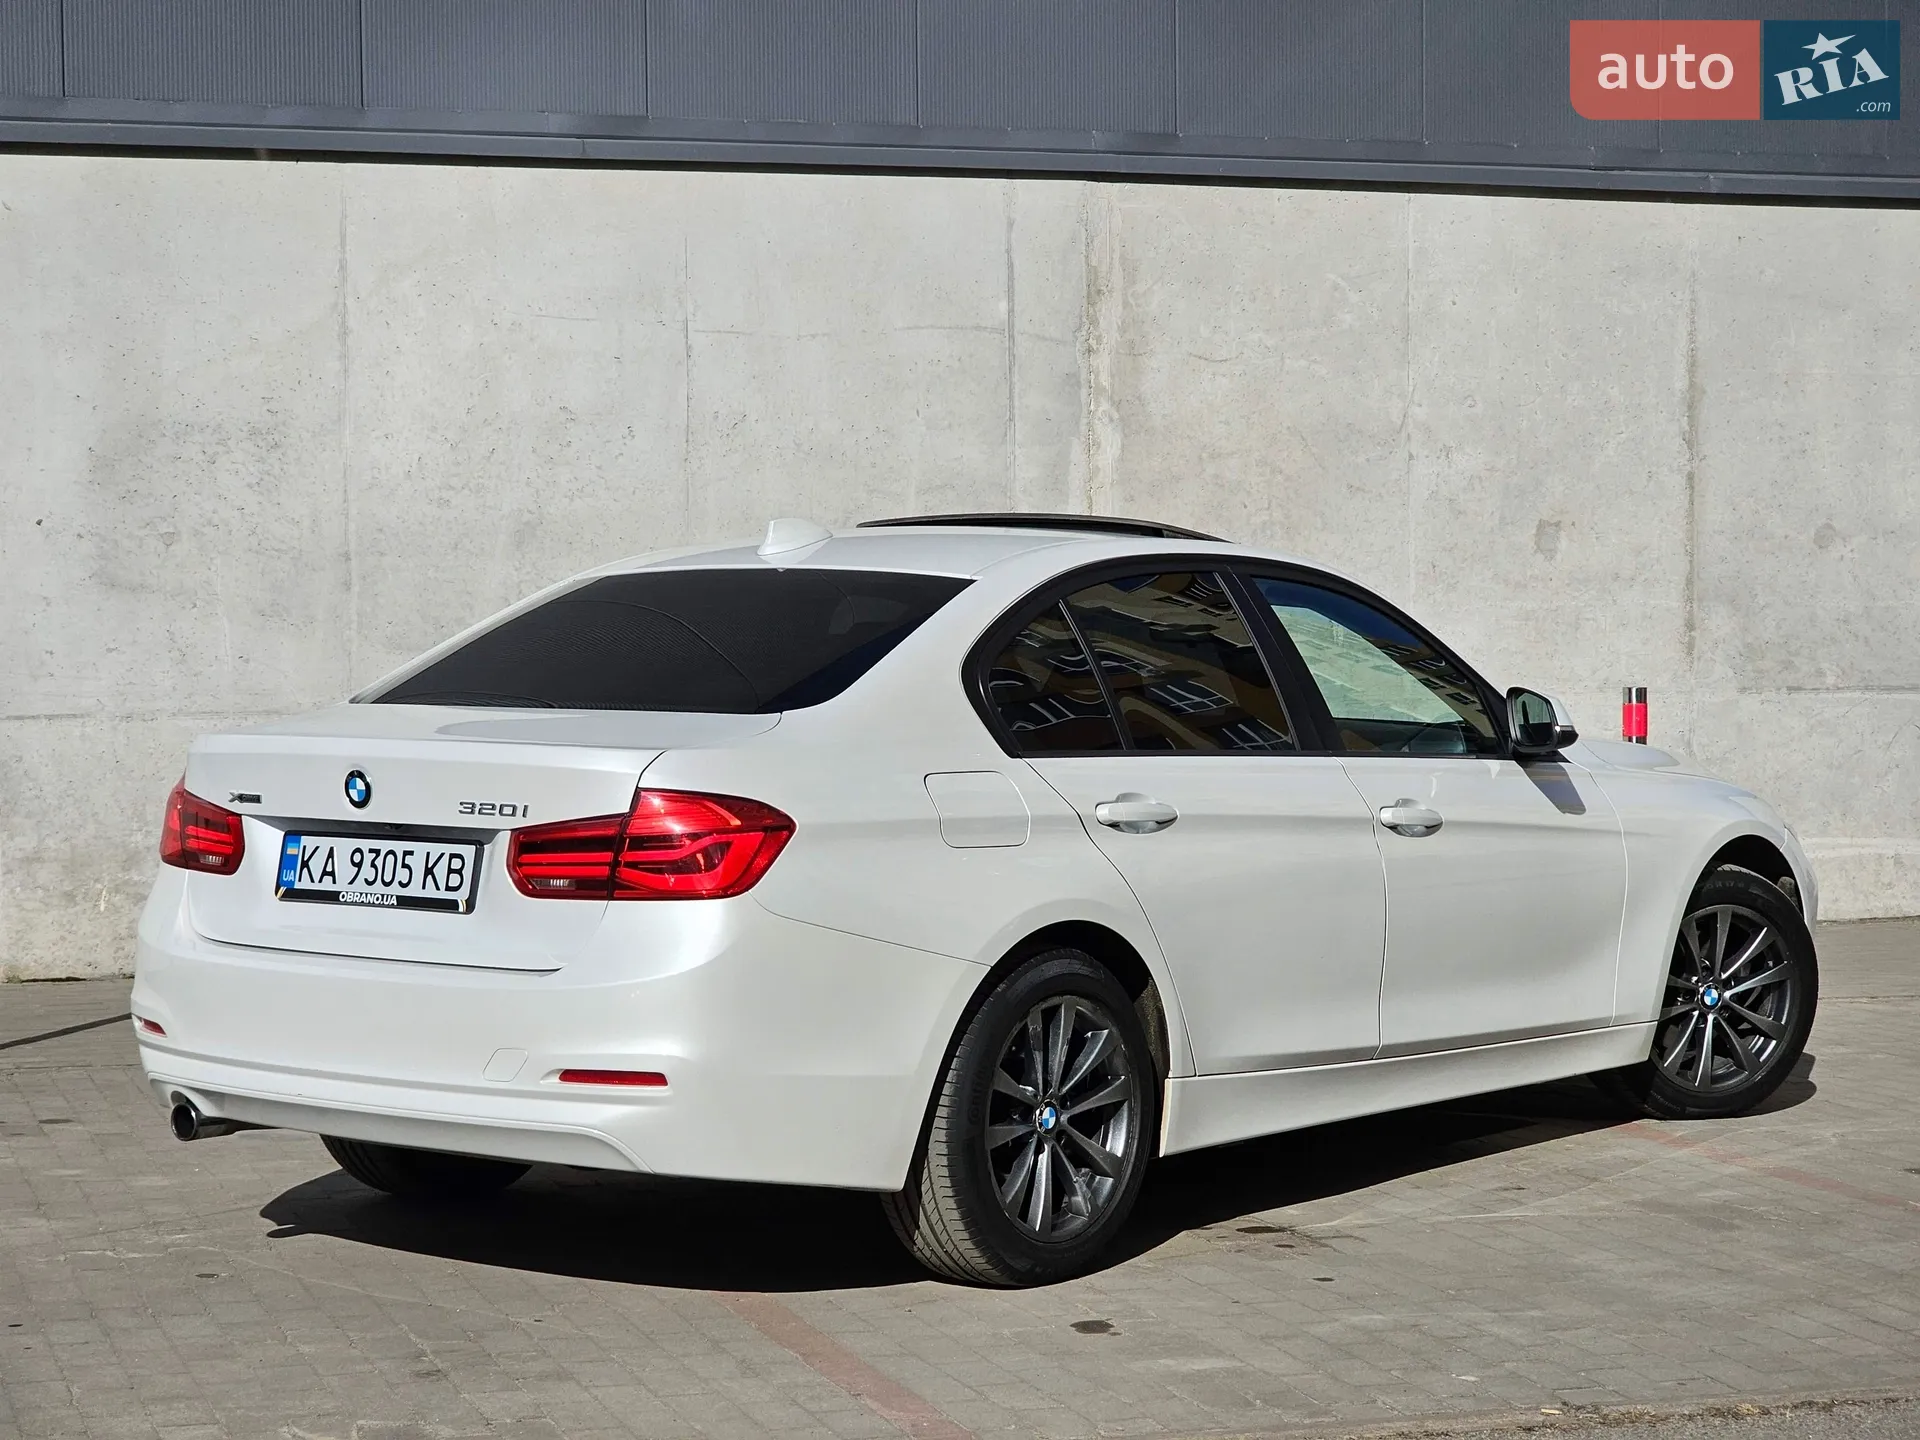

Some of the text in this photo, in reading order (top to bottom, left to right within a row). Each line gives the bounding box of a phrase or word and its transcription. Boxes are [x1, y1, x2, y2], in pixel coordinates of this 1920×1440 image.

[282, 869, 295, 882] UA
[297, 845, 466, 892] KA 9305 KB
[338, 891, 398, 906] OBRANO.UA
